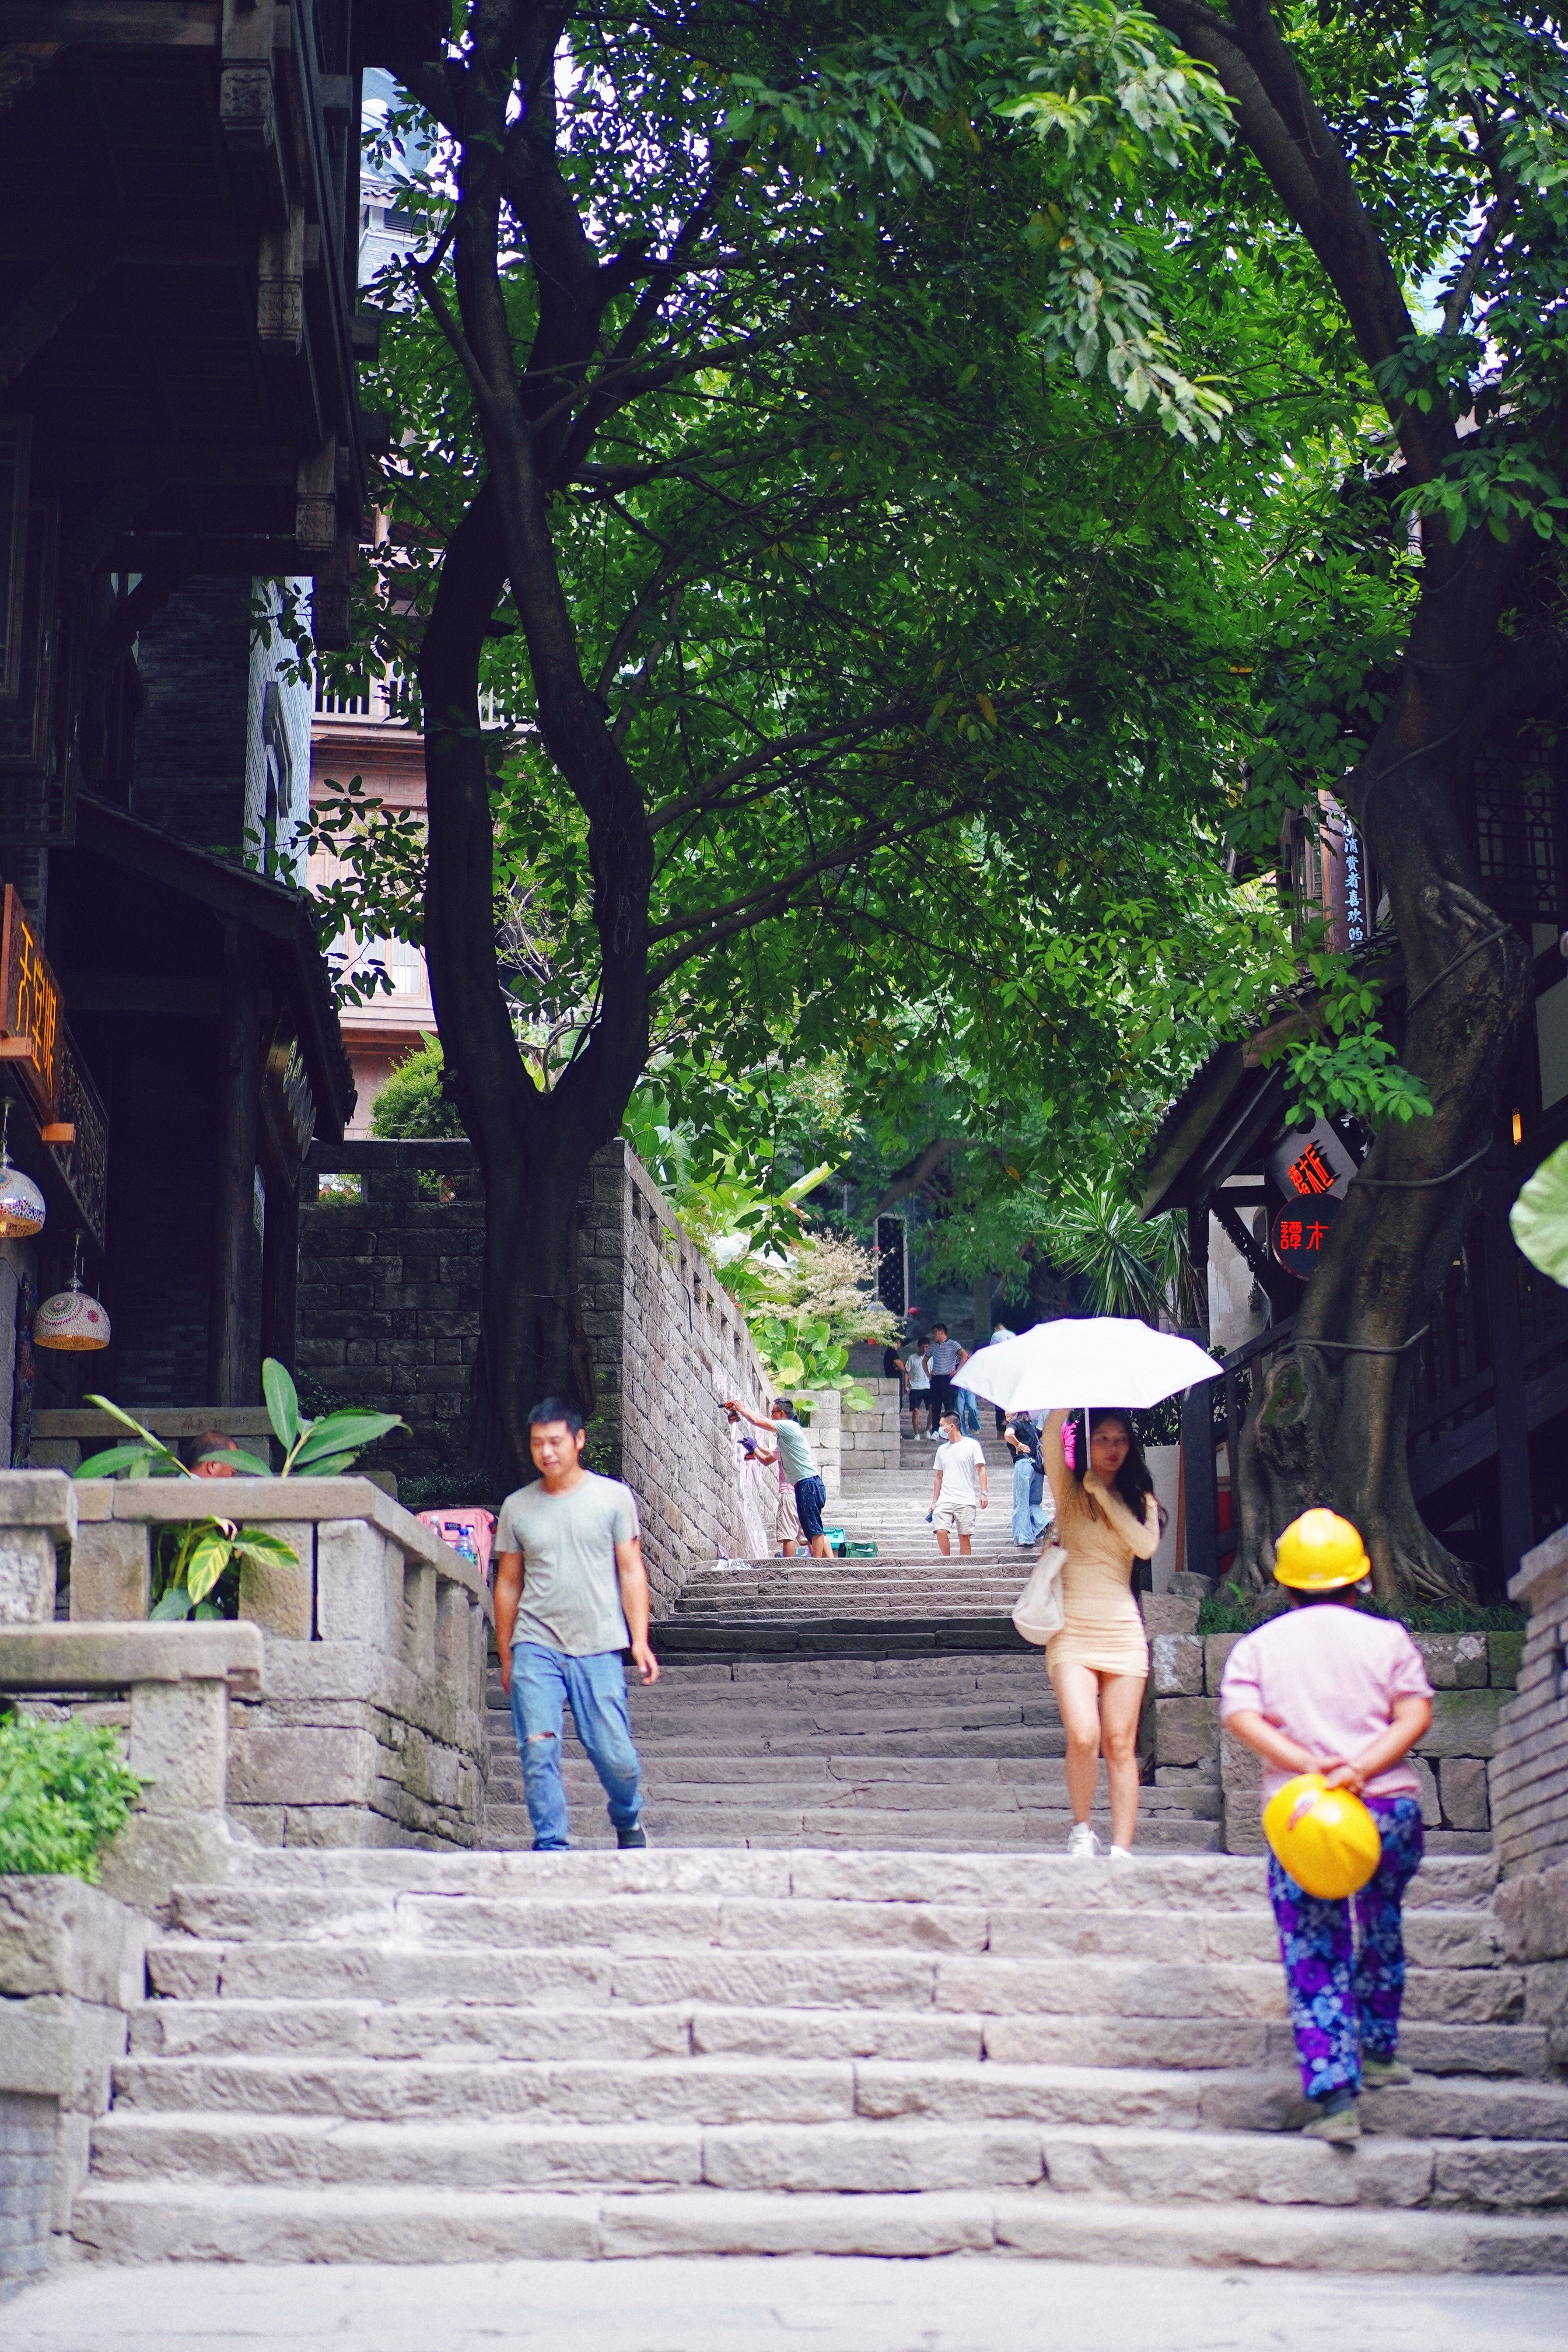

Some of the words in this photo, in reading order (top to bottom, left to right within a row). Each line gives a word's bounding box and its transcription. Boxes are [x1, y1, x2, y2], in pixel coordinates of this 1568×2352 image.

[1342, 818, 1363, 948] 消费者喜欢的
